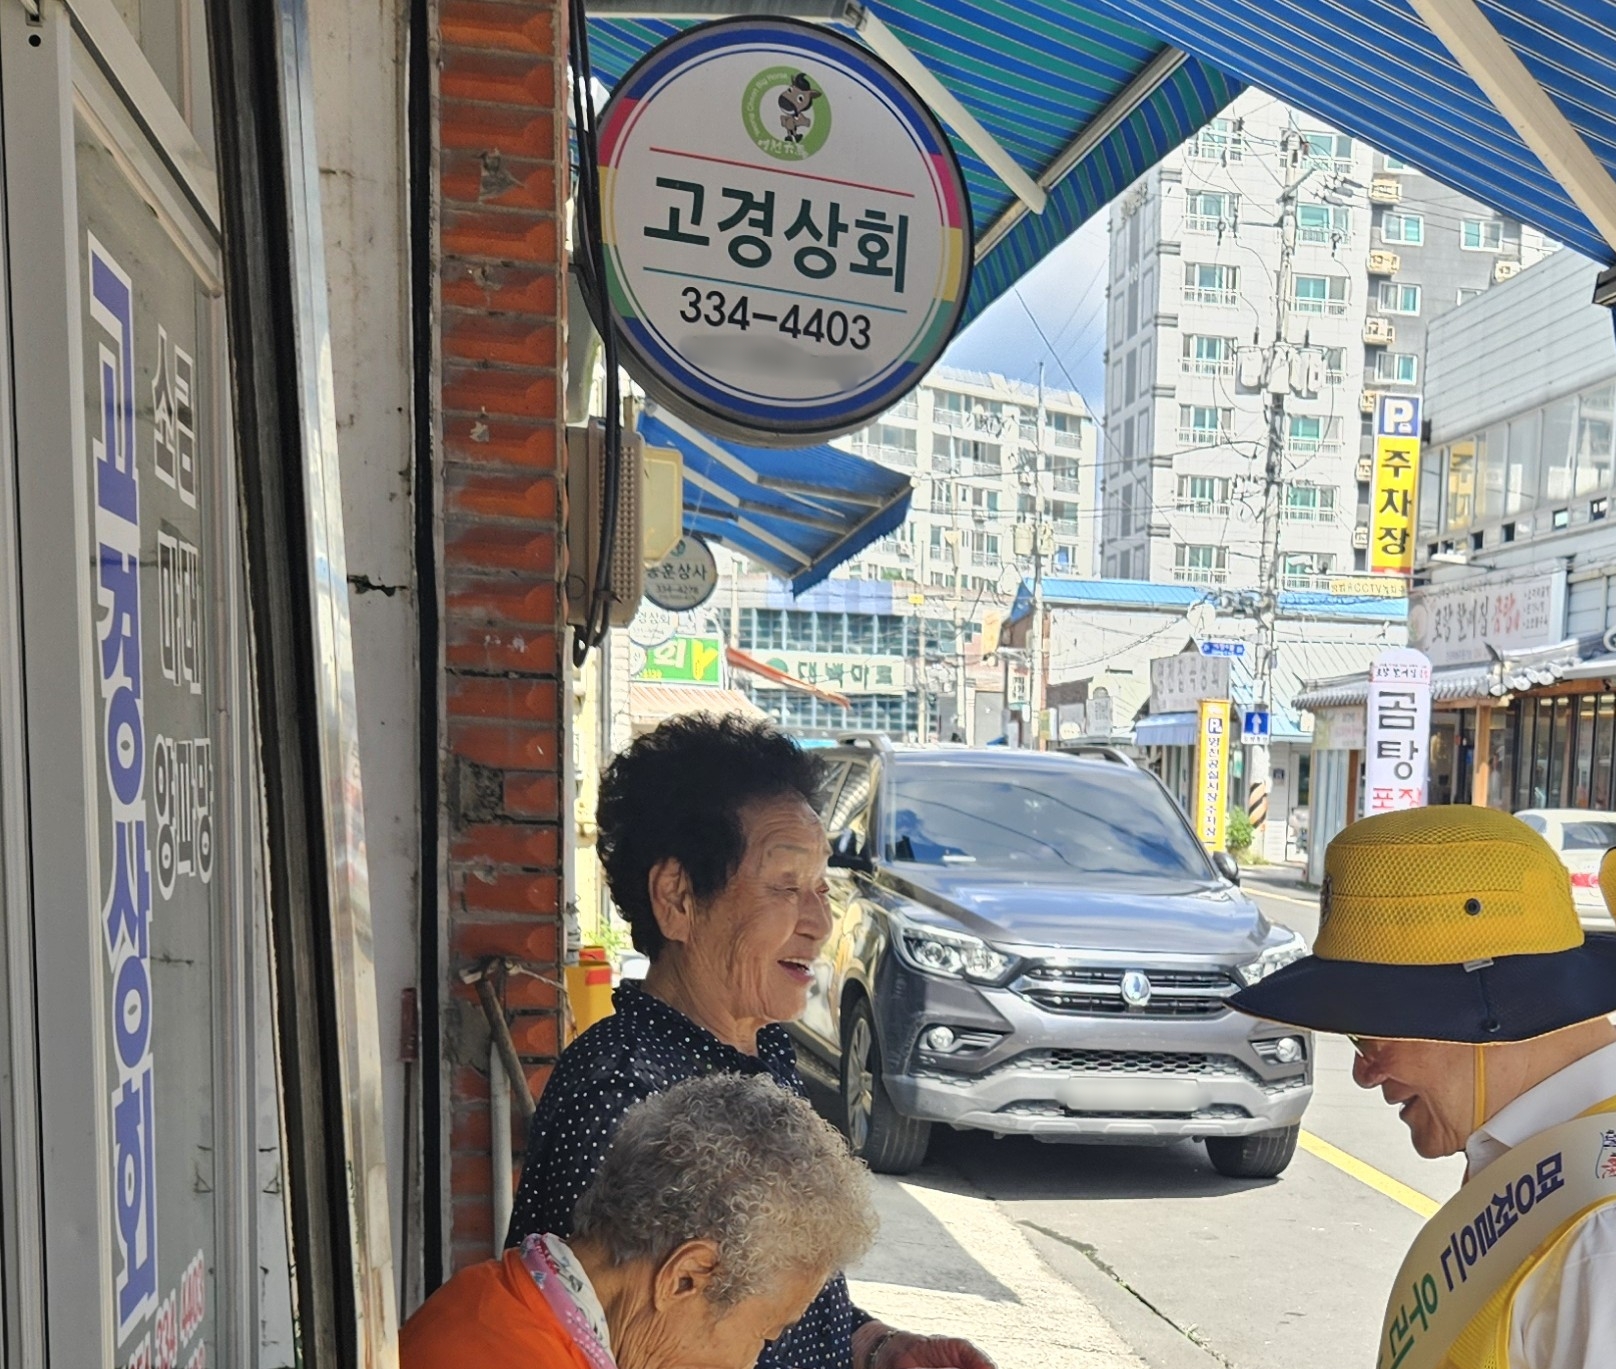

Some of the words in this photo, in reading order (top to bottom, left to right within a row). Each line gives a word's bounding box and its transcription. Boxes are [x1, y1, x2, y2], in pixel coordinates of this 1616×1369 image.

[644, 177, 909, 293] 고경상회
[679, 286, 872, 350] 334-4403
[152, 324, 197, 509] 소금
[1377, 449, 1412, 556] 주차장
[88, 228, 157, 1347] 고경상회
[1377, 691, 1418, 780] 곰탕
[153, 734, 214, 900] 양파망
[1372, 787, 1422, 808] 포장
[1440, 1151, 1565, 1293] 명절은
[180, 1250, 205, 1346] 4403
